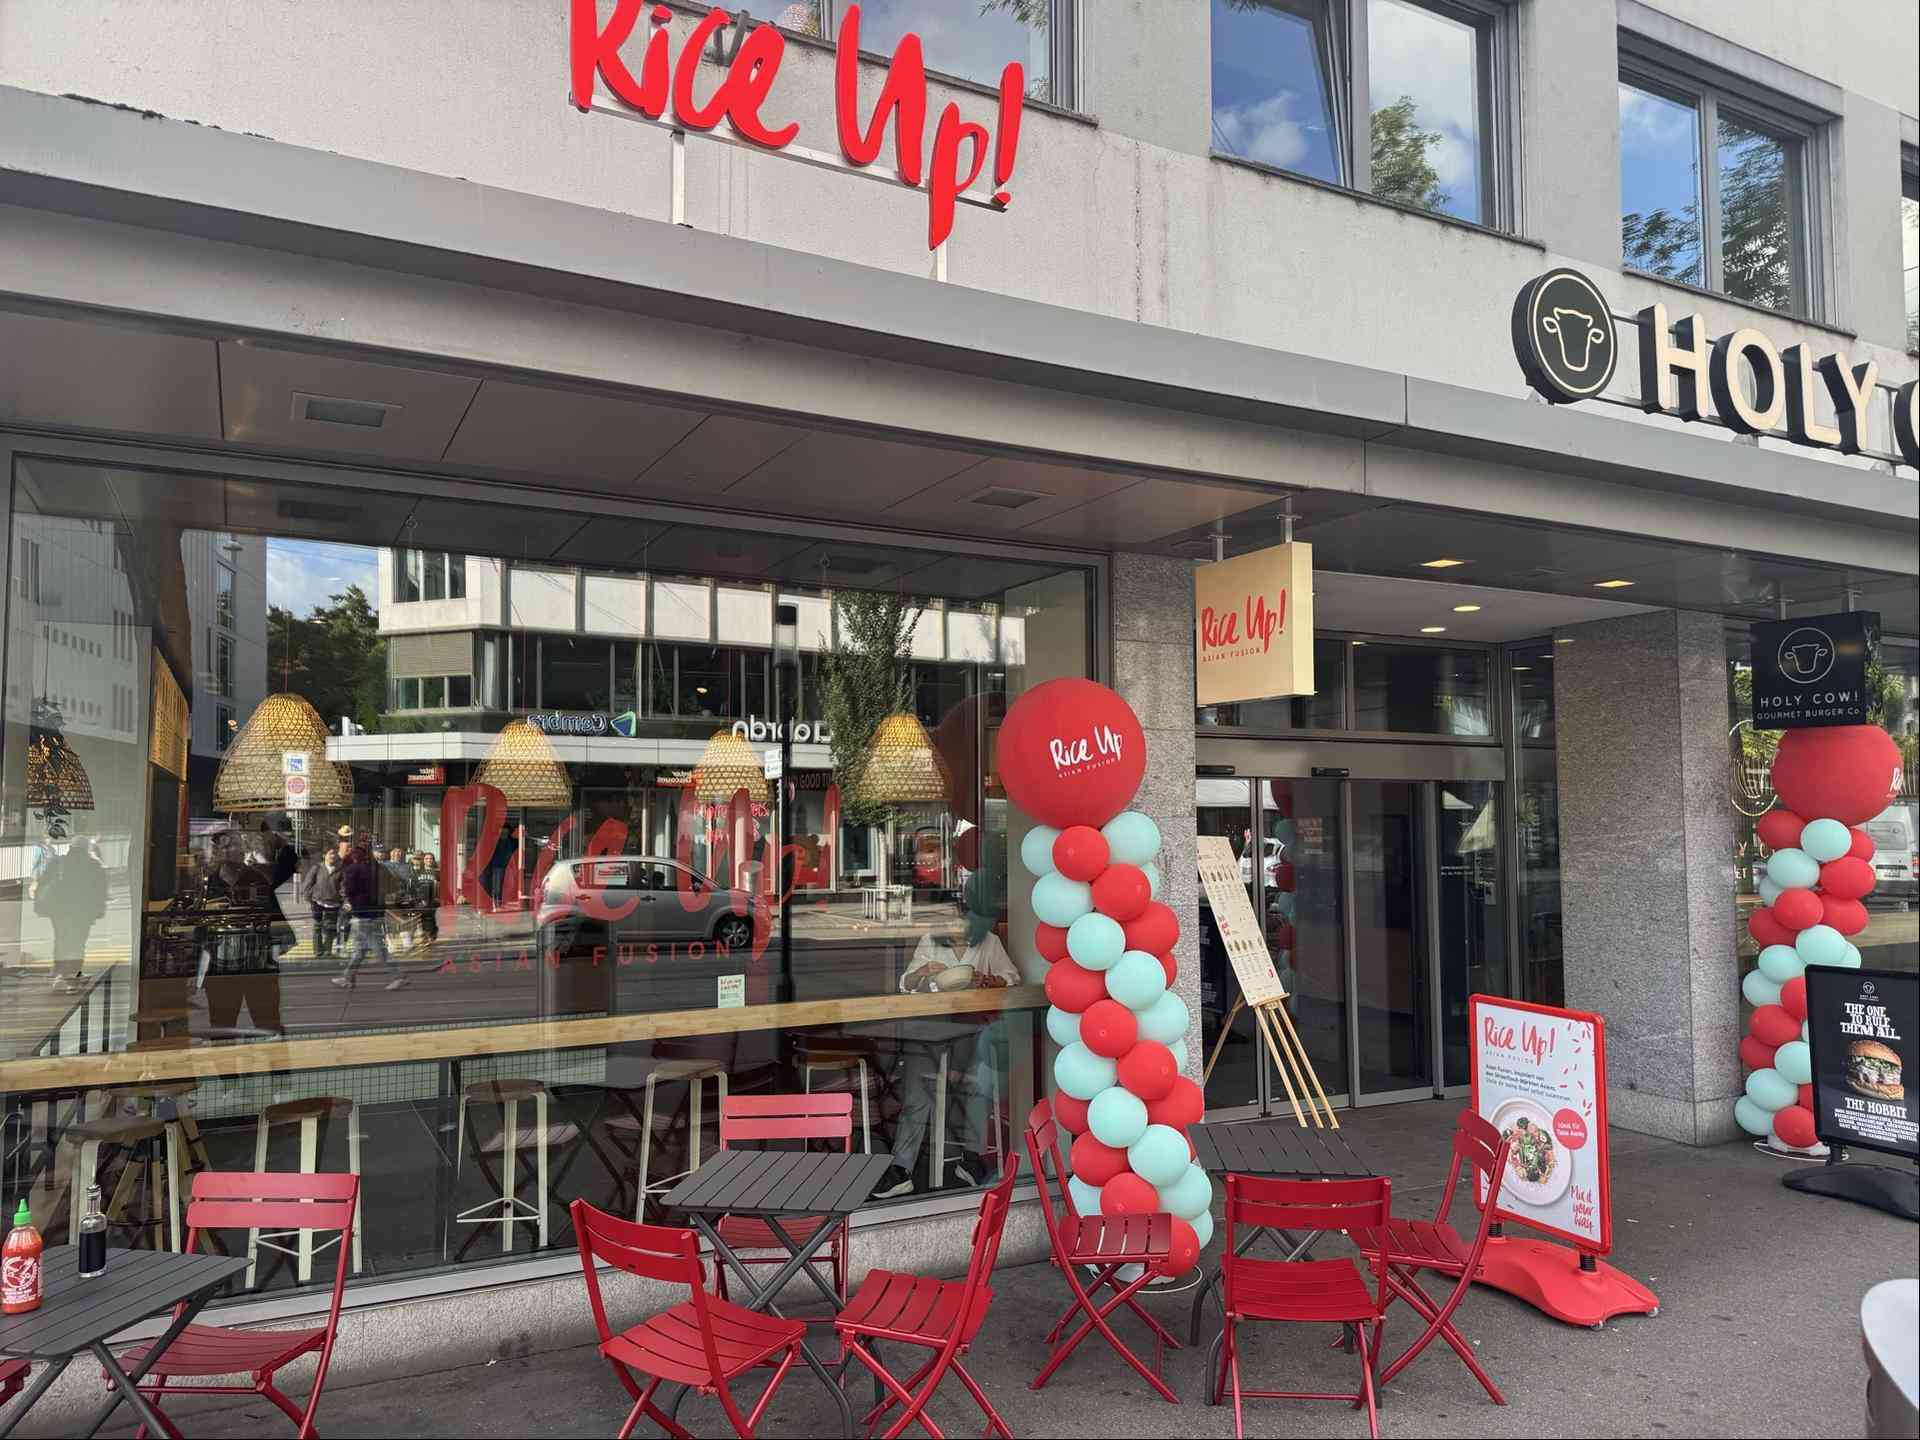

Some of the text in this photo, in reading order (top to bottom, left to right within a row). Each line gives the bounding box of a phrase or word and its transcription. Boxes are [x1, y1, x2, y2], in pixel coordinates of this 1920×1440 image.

[570, 0, 1024, 250] Rice Up!
[1640, 302, 1880, 453] HOLY
[1201, 588, 1287, 655] Rice Up!
[1756, 710, 1801, 720] GOURMET
[1805, 708, 1844, 718] BURGER
[1760, 690, 1859, 708] HOLY COW!
[1050, 724, 1123, 770] Rice Up
[436, 939, 731, 976] ASIAN FUSION
[1844, 1002, 1887, 1018] THE ONE
[1850, 1013, 1891, 1028] TO RULE
[1484, 1016, 1556, 1066] Rice Up!
[1840, 1021, 1875, 1036] THEM
[1844, 1096, 1908, 1120] THE HOBBIT
